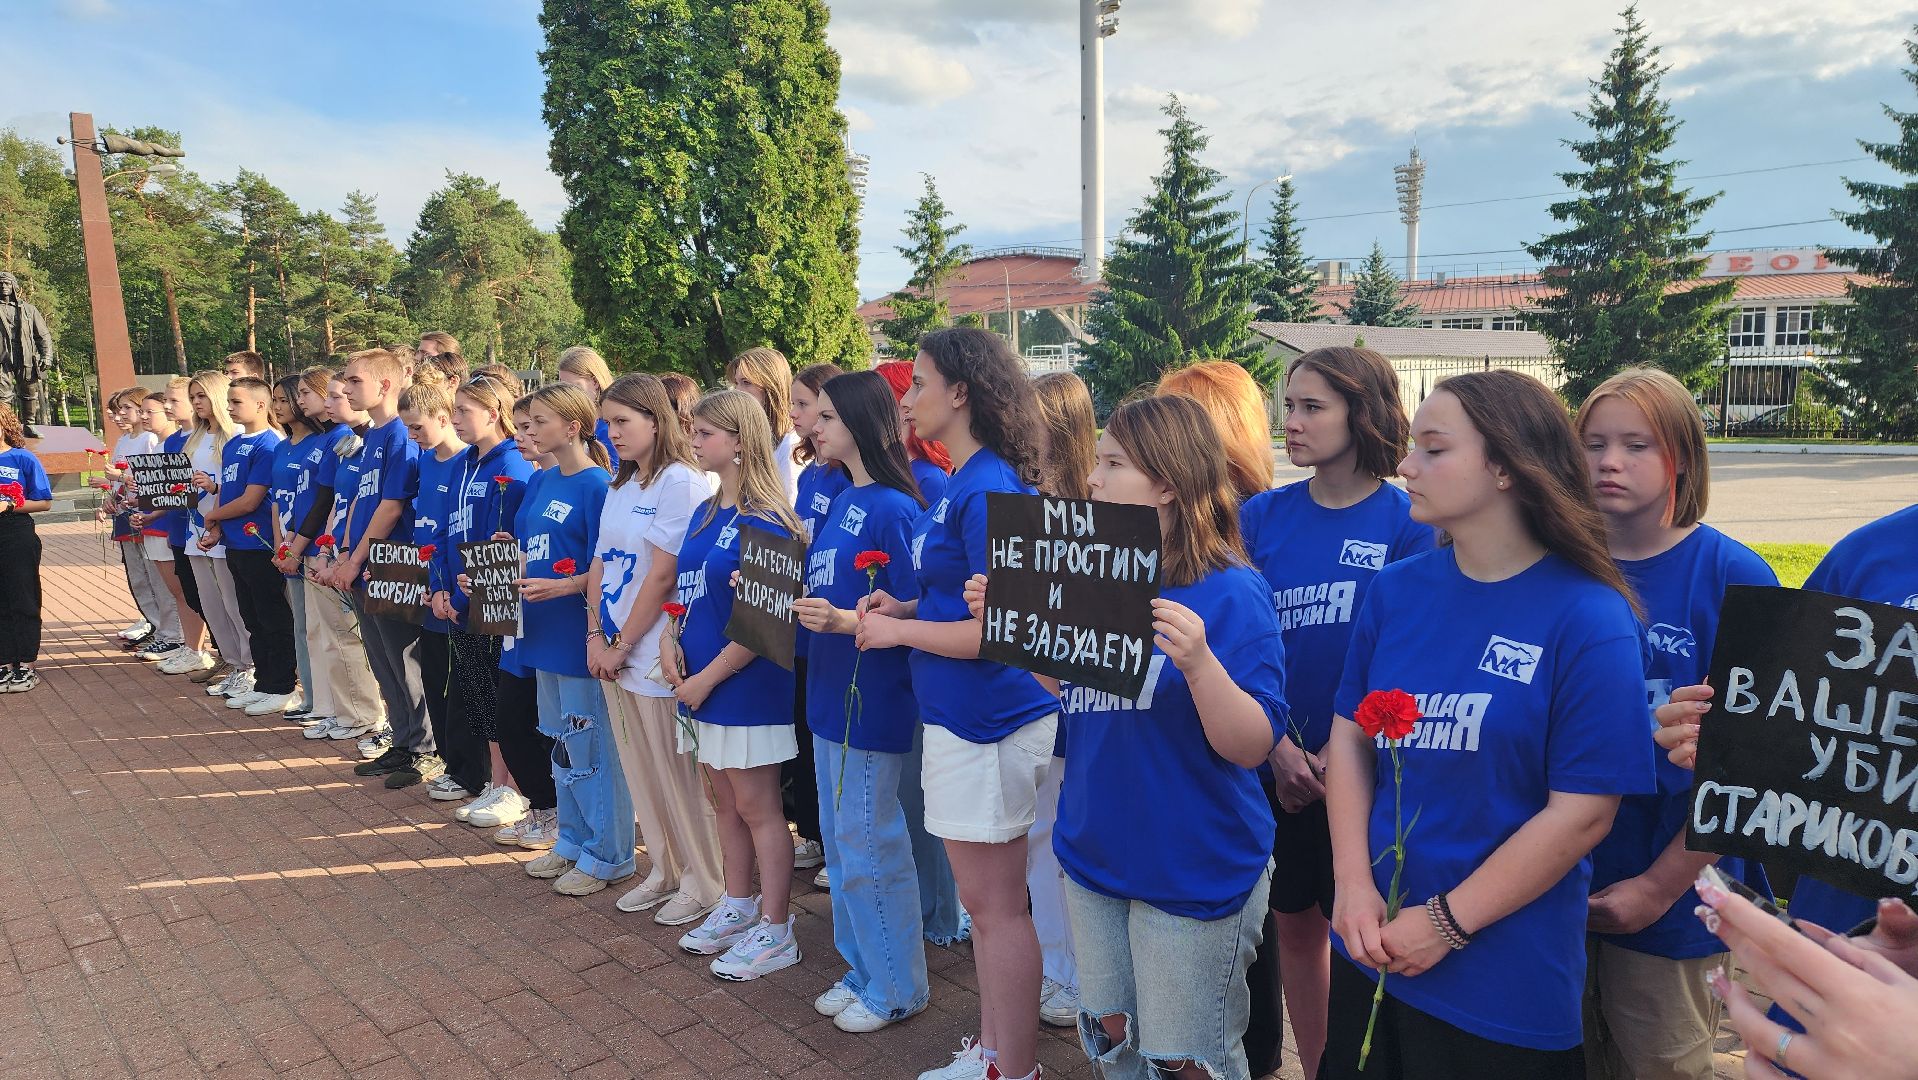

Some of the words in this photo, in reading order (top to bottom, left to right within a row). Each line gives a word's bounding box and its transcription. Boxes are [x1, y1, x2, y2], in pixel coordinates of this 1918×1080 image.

[138, 484, 164, 496] ВМЕСТЕ
[152, 493, 187, 507] СТРАНОЙ
[1043, 498, 1095, 537] МЫ
[743, 541, 802, 582] ДАГЕСТАН
[992, 536, 1024, 569] НЕ
[1034, 539, 1158, 584] ПРОСТИМ
[367, 580, 427, 606] СКОРБИМ
[486, 585, 512, 602] БЫТЬ
[736, 575, 794, 624] СКОРБИМ
[1048, 582, 1063, 610] И
[986, 606, 1019, 644] НЕ
[1022, 613, 1143, 676] ЗАБУДЕМ
[1825, 606, 1918, 680] ЗА
[1724, 666, 1918, 747] ВАШЕ
